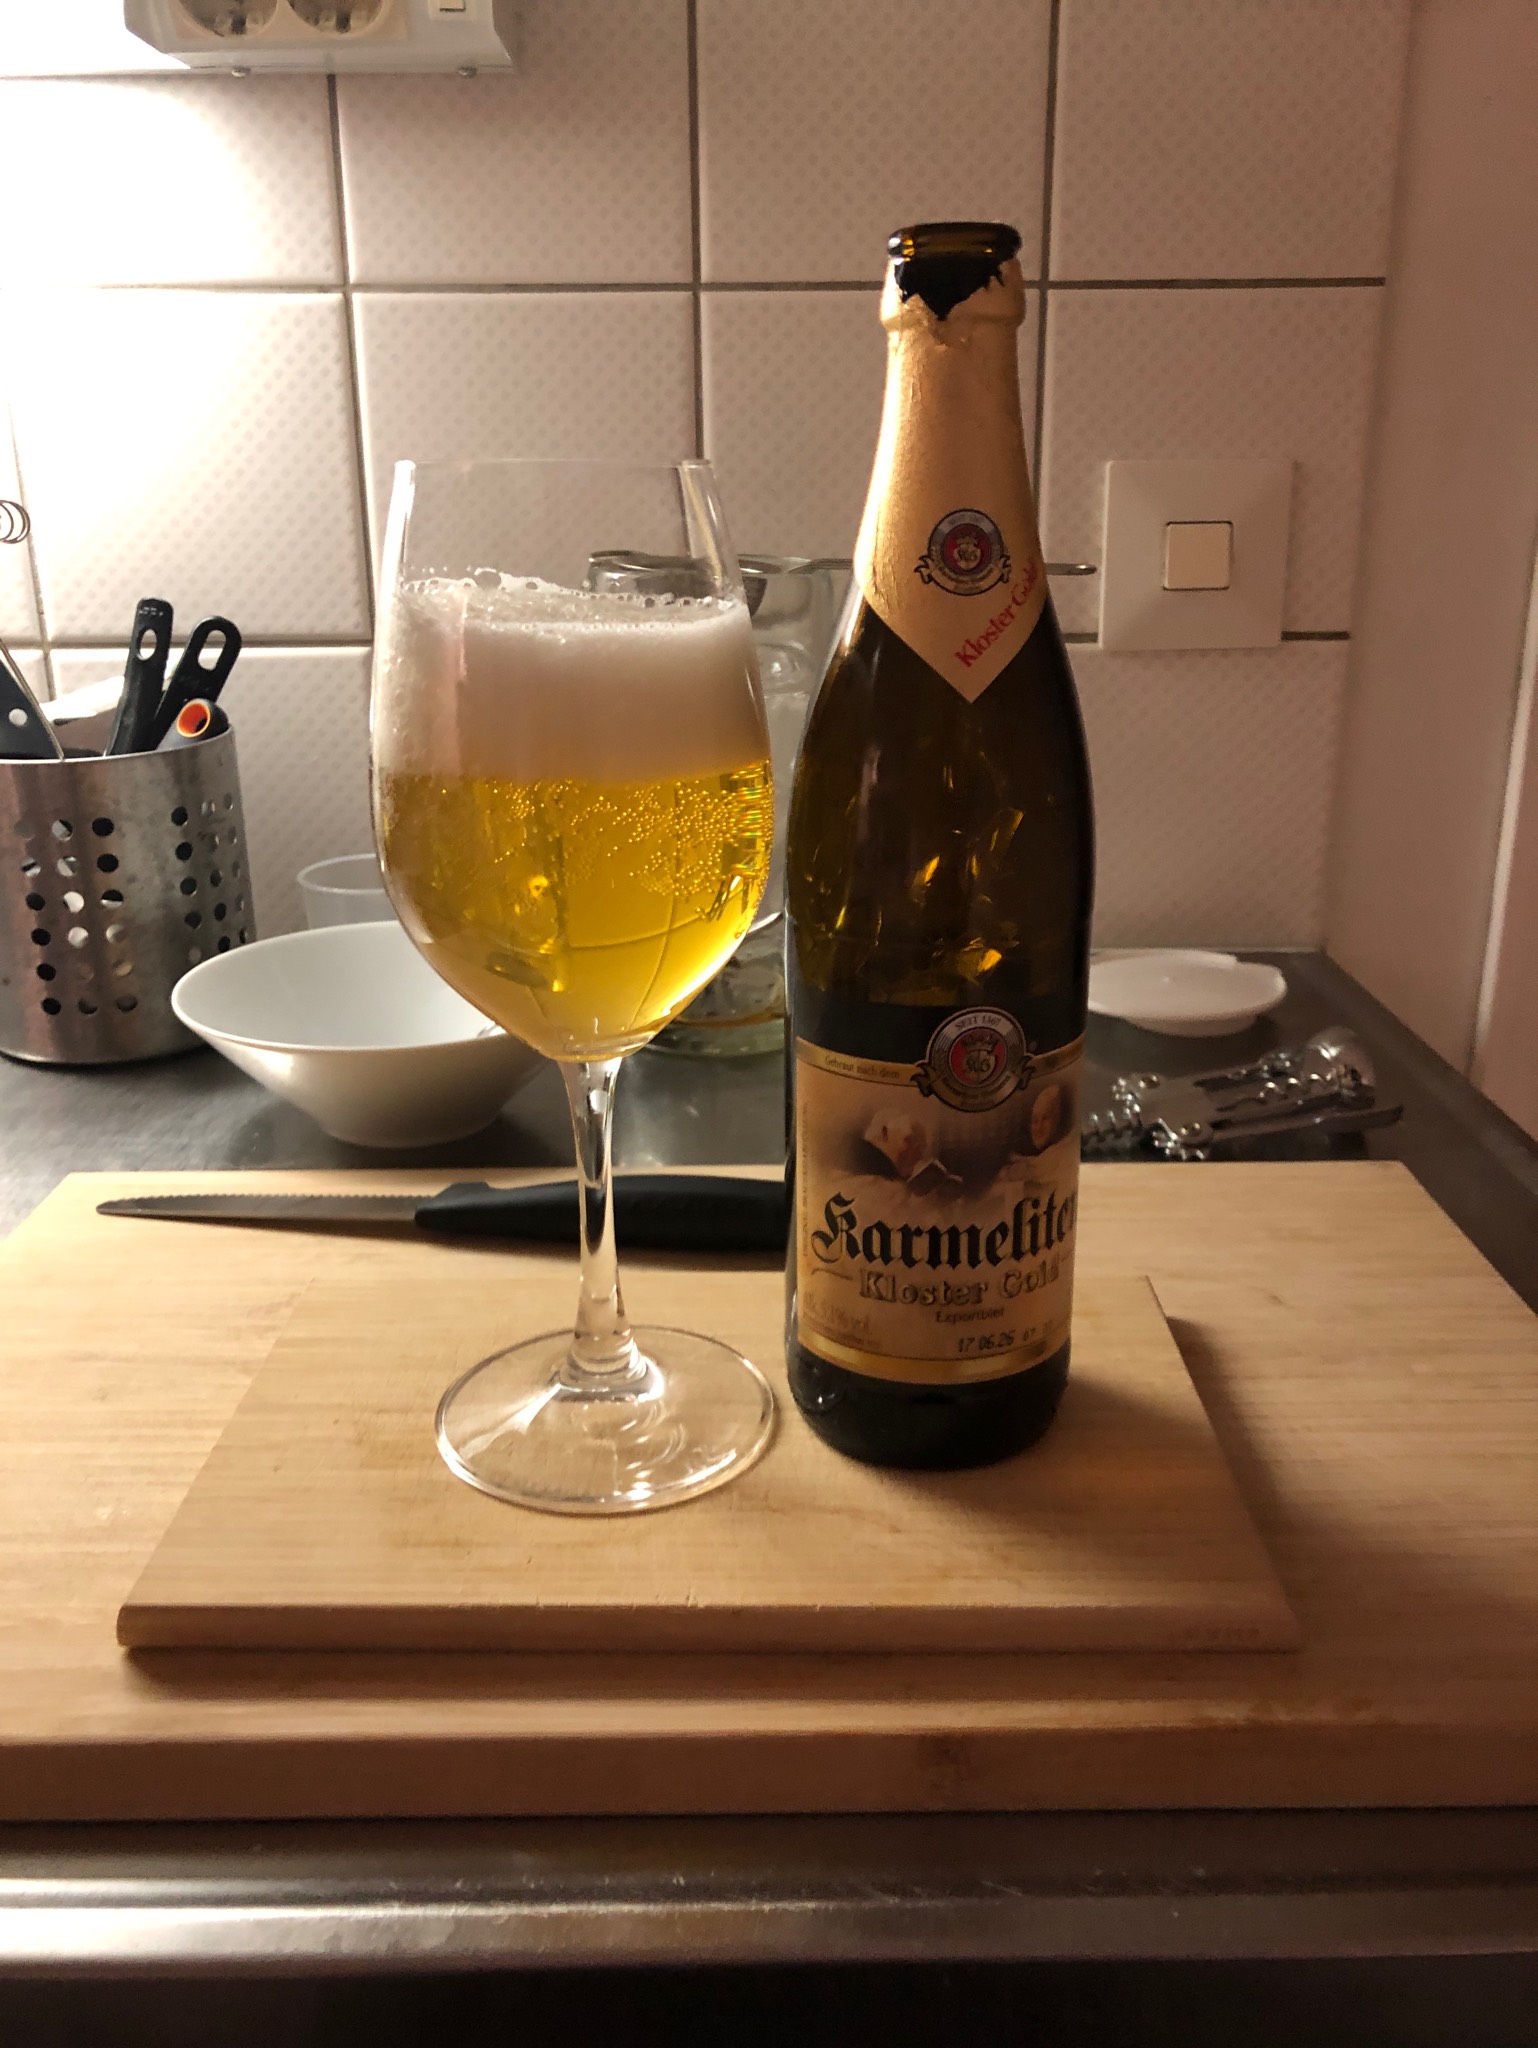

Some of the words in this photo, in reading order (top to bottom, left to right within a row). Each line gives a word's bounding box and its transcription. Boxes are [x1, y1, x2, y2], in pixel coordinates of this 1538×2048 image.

[954, 606, 1014, 667] Kloster
[856, 1064, 878, 1076] nach
[859, 1266, 988, 1306] Kloster
[1000, 1255, 1060, 1299] Gold
[935, 1307, 1005, 1324] Exportbier
